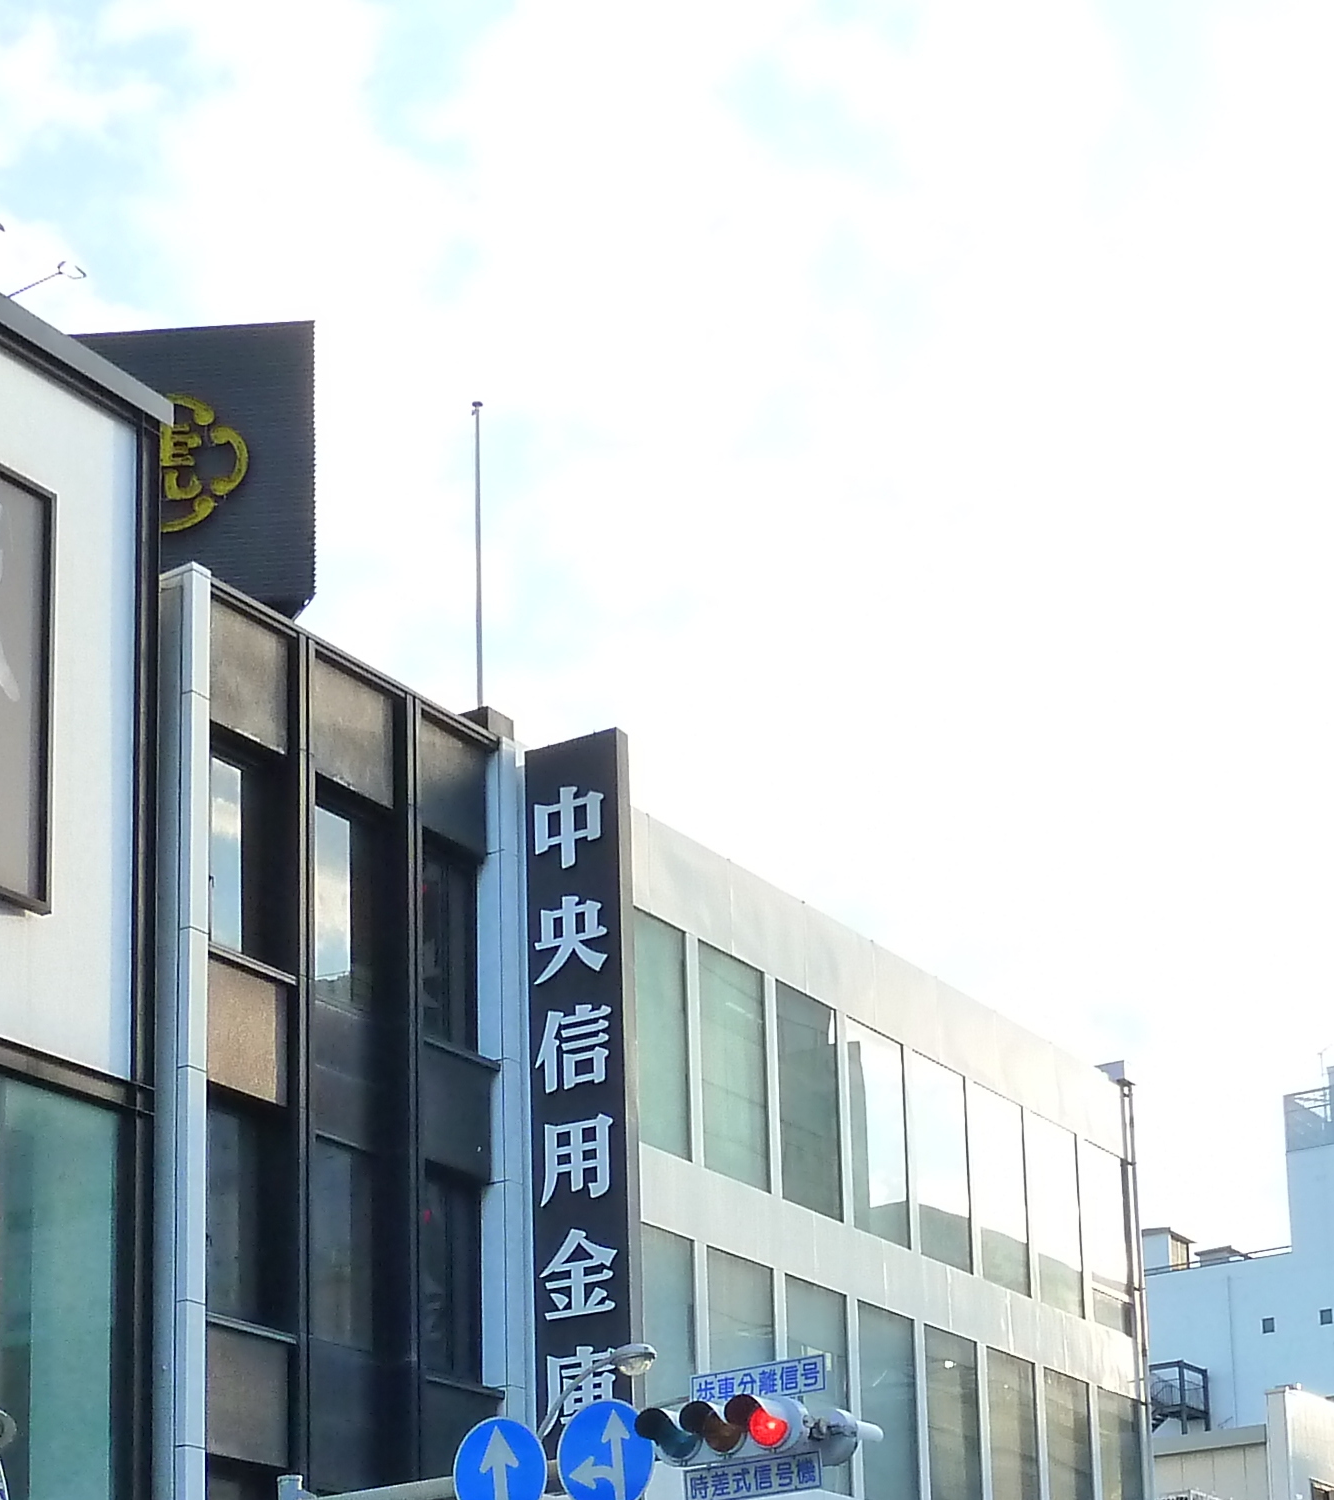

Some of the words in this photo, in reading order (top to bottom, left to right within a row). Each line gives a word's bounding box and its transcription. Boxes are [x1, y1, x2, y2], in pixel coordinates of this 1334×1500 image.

[695, 1361, 820, 1403] 歩車分離信号
[689, 1457, 817, 1500] 時差式信号機
